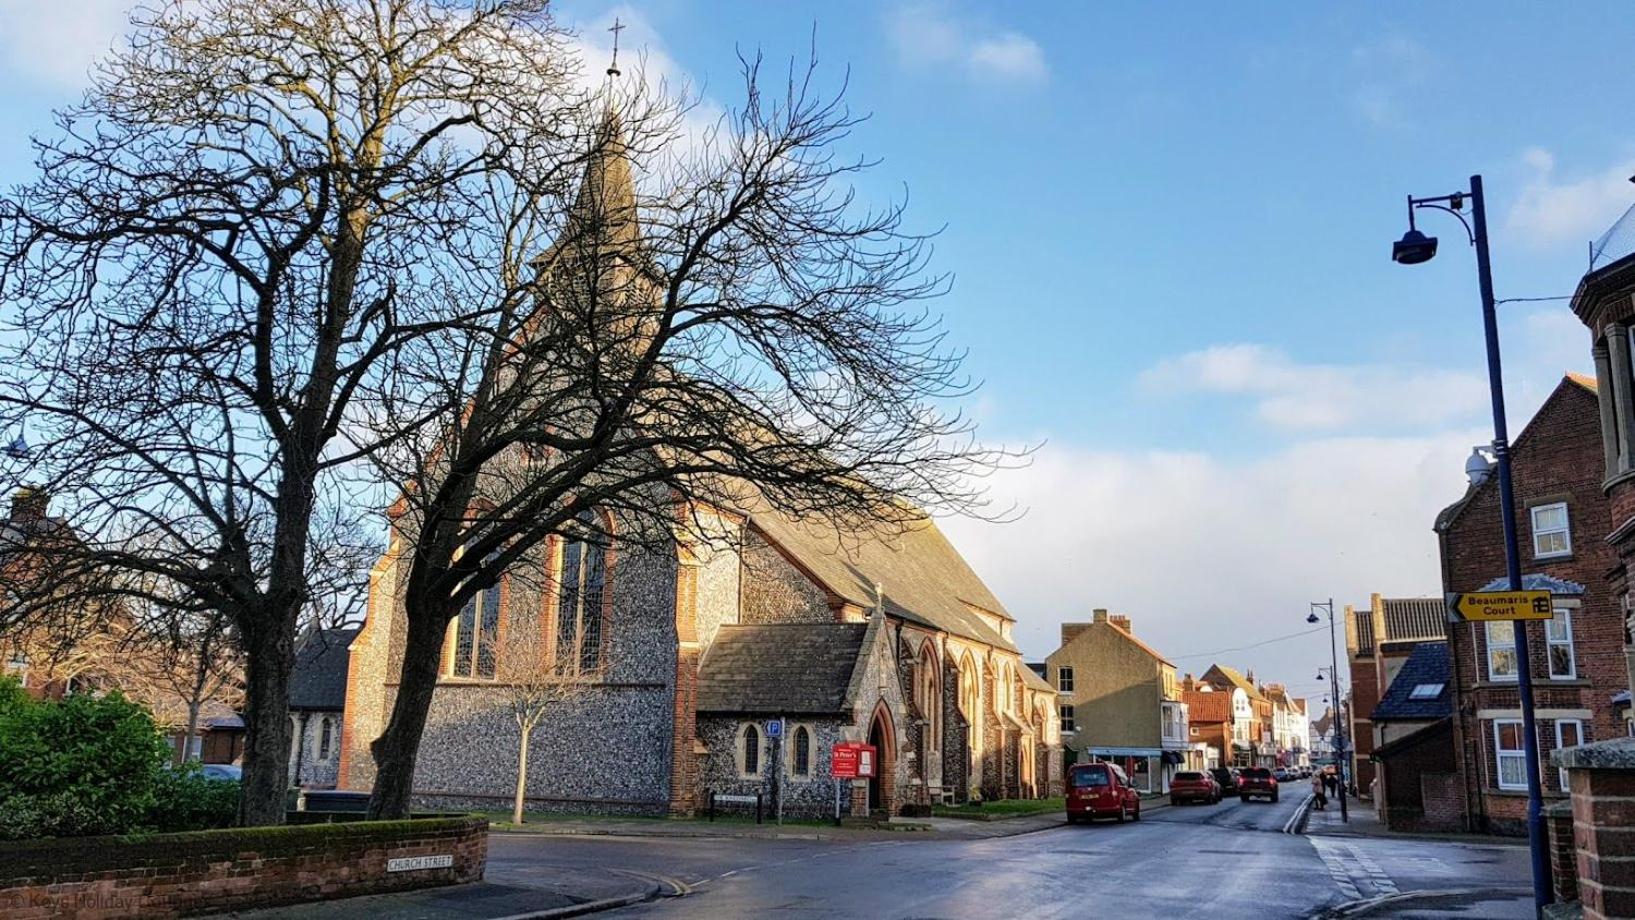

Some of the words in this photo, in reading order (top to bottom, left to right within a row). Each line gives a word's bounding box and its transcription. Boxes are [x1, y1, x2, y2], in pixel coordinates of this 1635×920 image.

[1468, 596, 1528, 605] Beaumaris
[1484, 606, 1516, 615] Court
[772, 724, 778, 732] P
[389, 858, 422, 870] CHURCH
[424, 856, 451, 867] STREET
